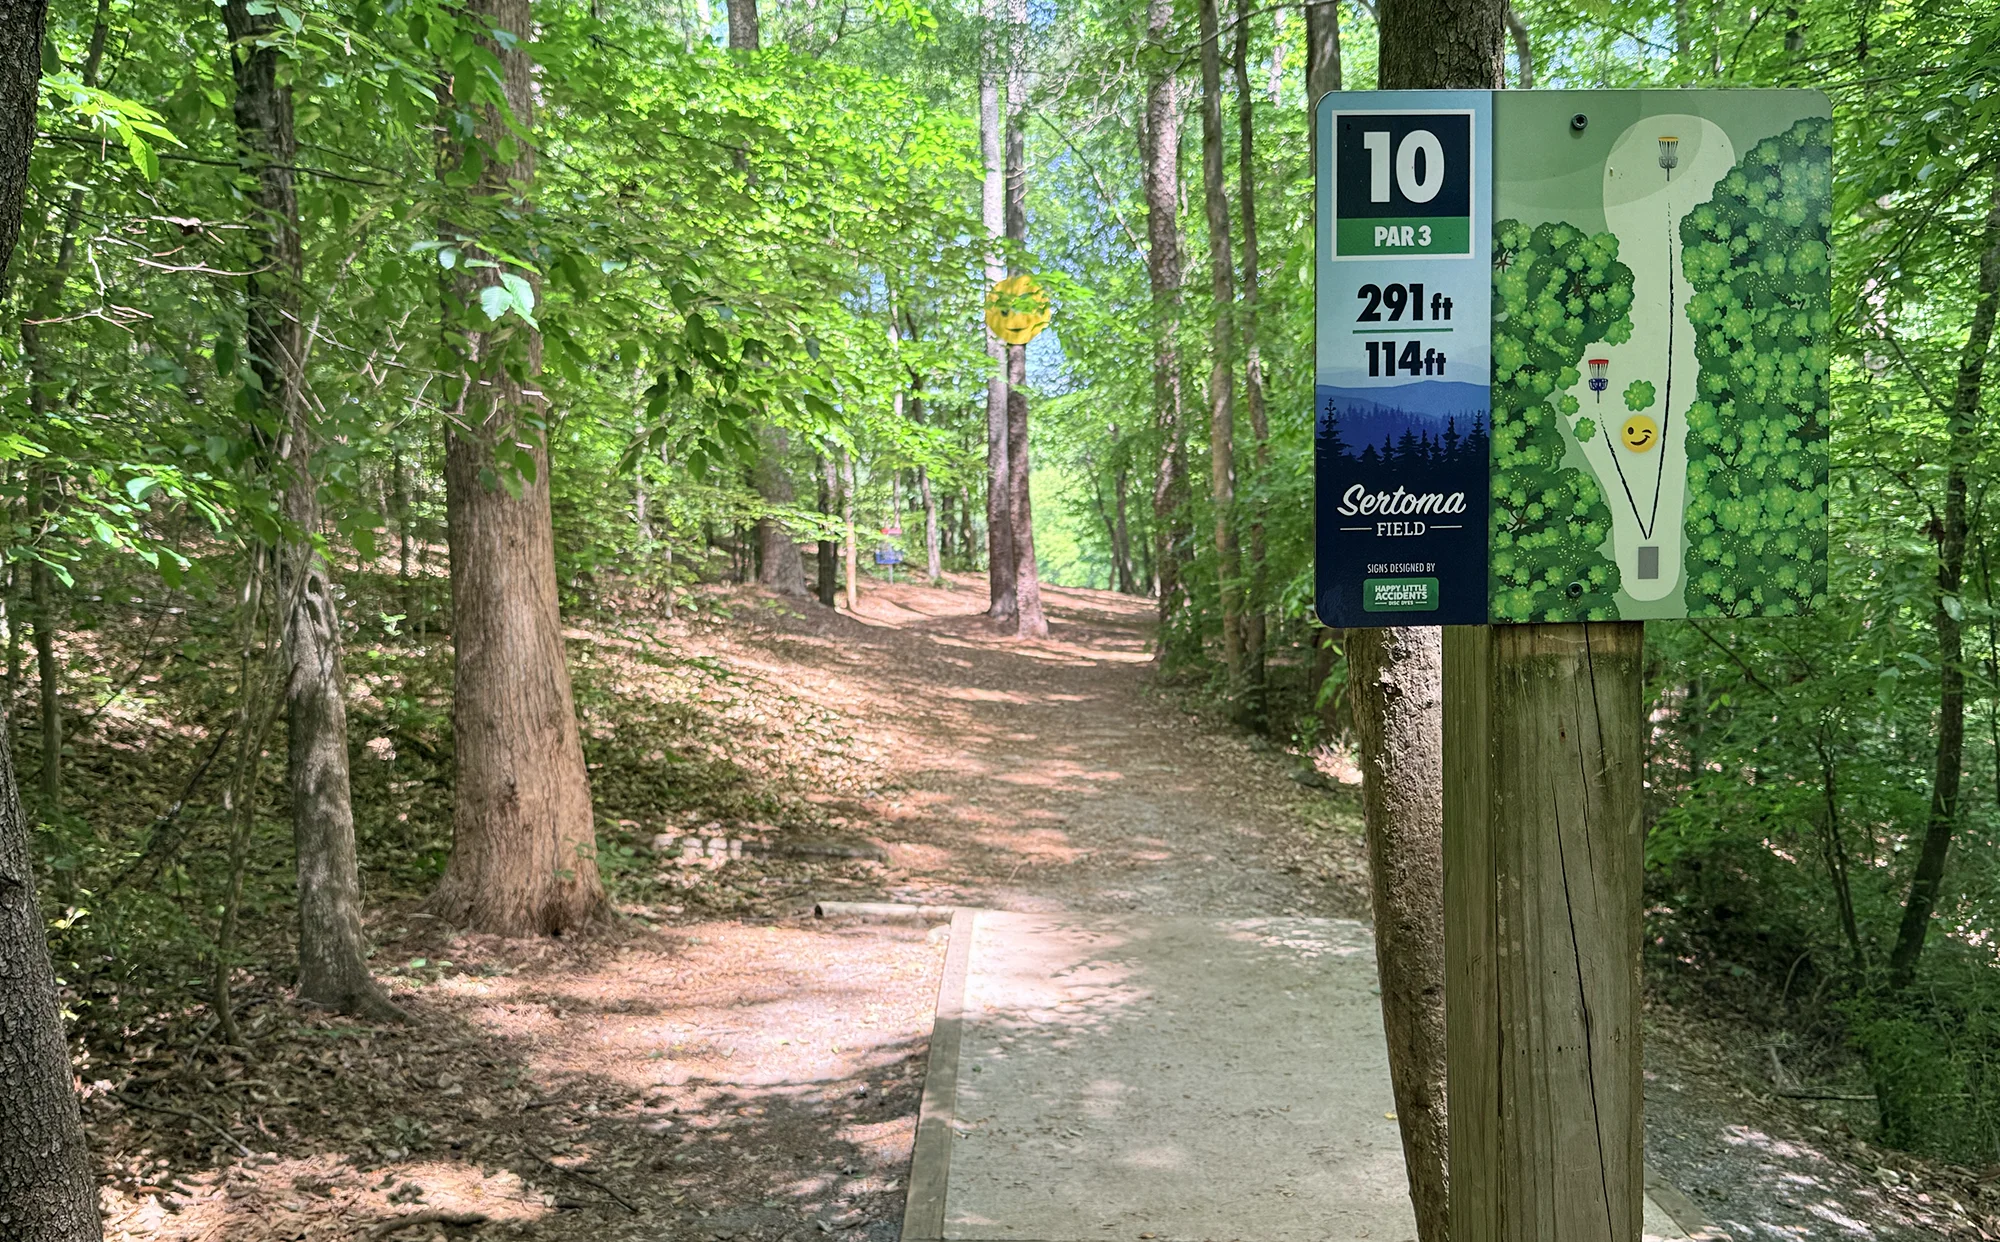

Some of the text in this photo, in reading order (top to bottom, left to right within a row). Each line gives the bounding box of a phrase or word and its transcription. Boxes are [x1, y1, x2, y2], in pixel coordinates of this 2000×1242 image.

[1363, 129, 1445, 203] 10
[1374, 225, 1432, 247] PAR 3
[1356, 283, 1453, 322] 291 ft
[1365, 341, 1446, 377] 114ft
[1336, 484, 1467, 516] Sertoma
[1376, 521, 1426, 537] FIELD
[1367, 562, 1436, 574] SIGNS DESIGNED BY
[1375, 592, 1427, 600] ACCIDENTS
